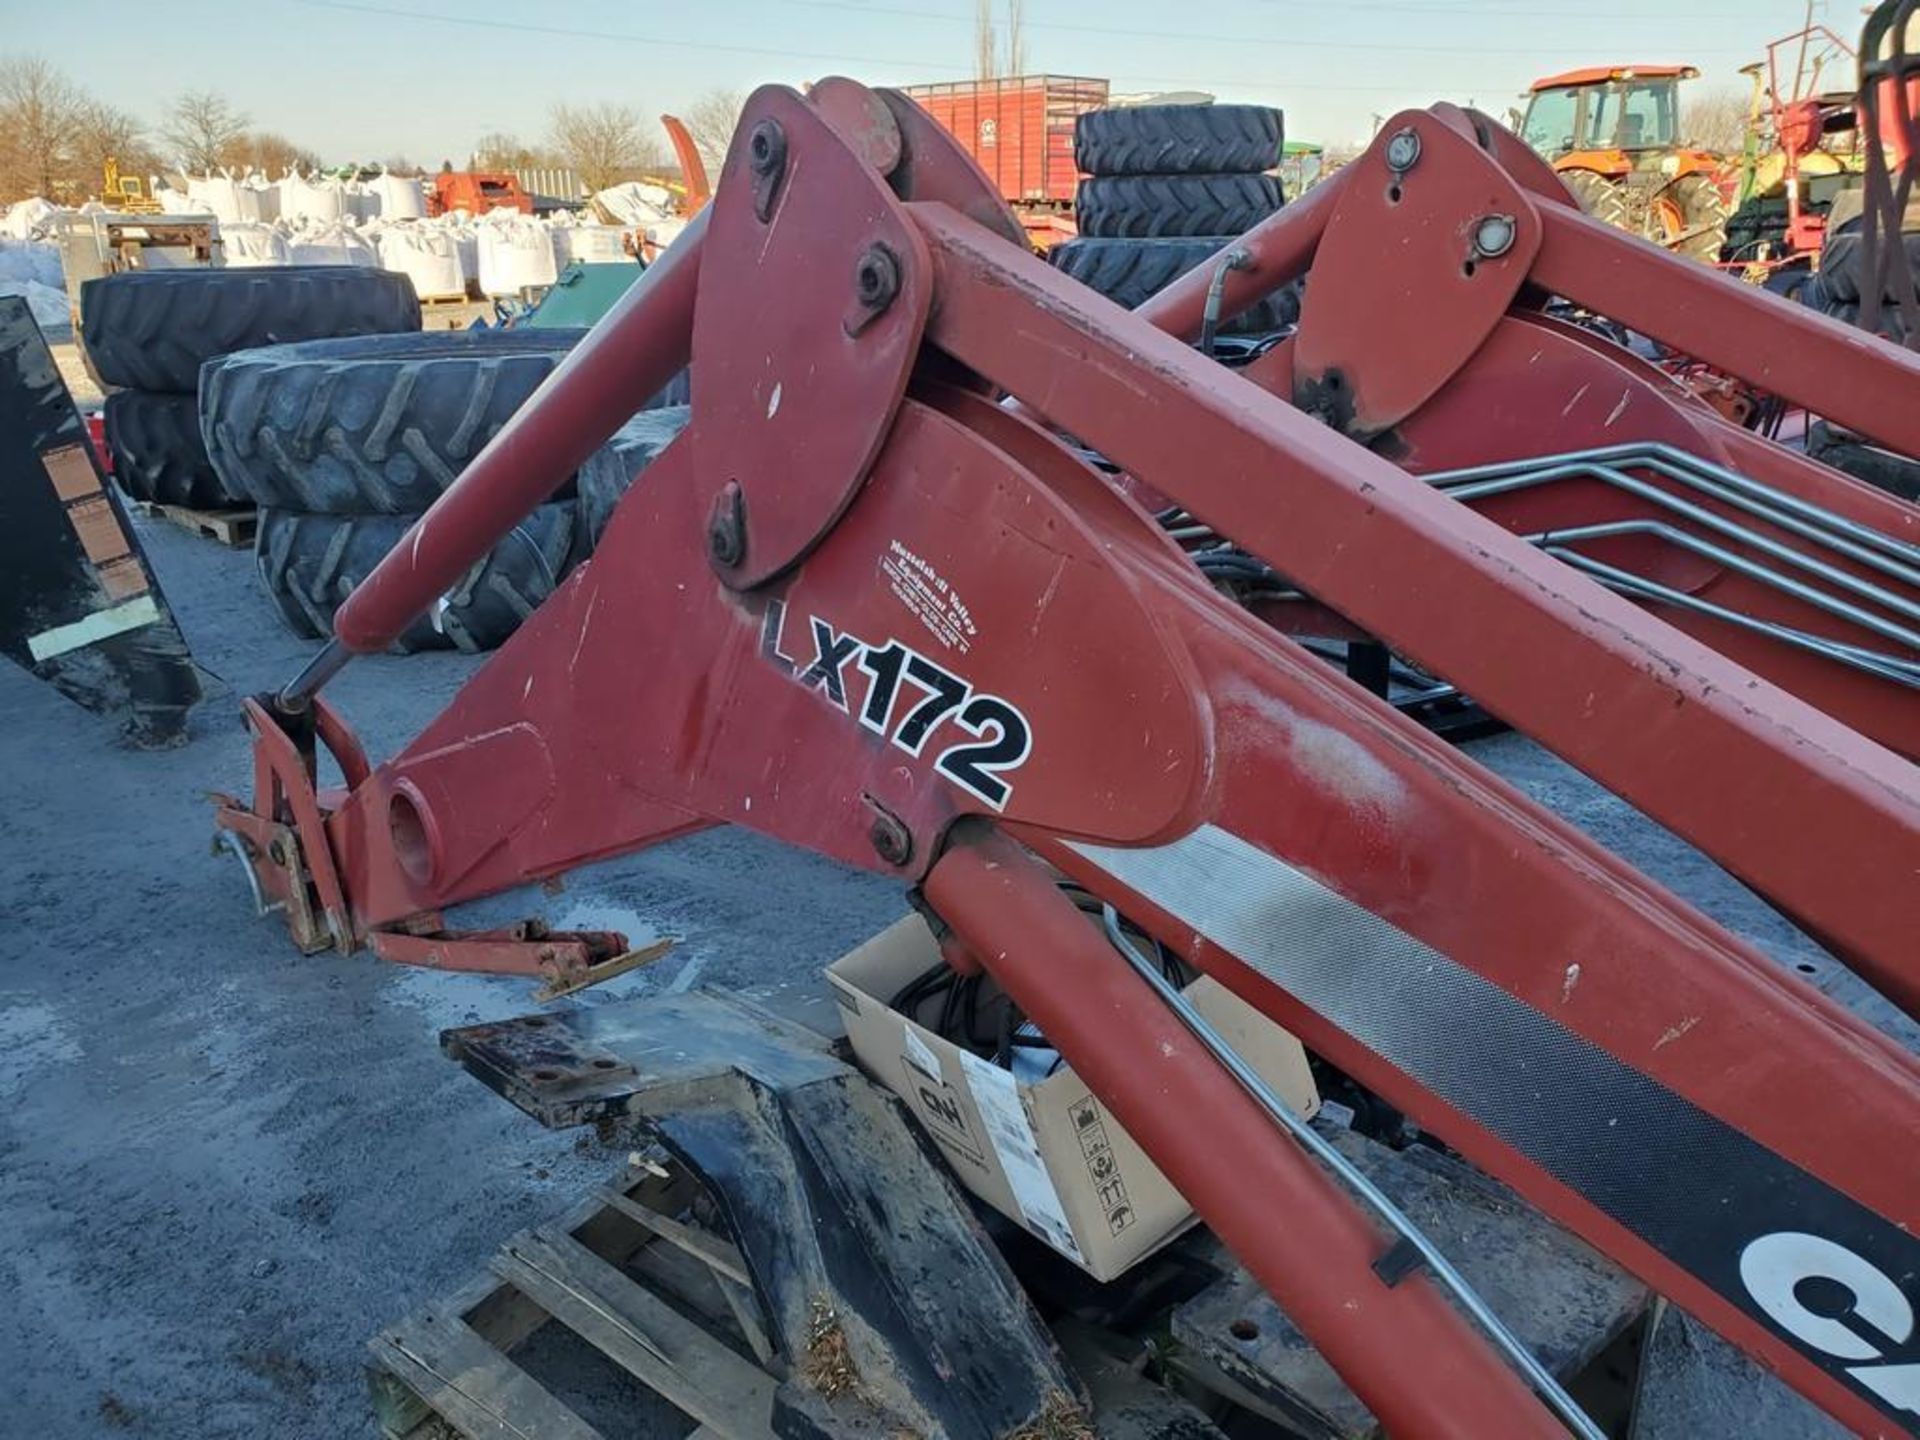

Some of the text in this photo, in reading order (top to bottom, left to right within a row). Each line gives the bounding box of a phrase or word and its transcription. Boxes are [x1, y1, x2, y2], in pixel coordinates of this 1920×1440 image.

[949, 591, 977, 635] Valley
[760, 599, 1032, 813] LX172
[1740, 1231, 1920, 1415] C
